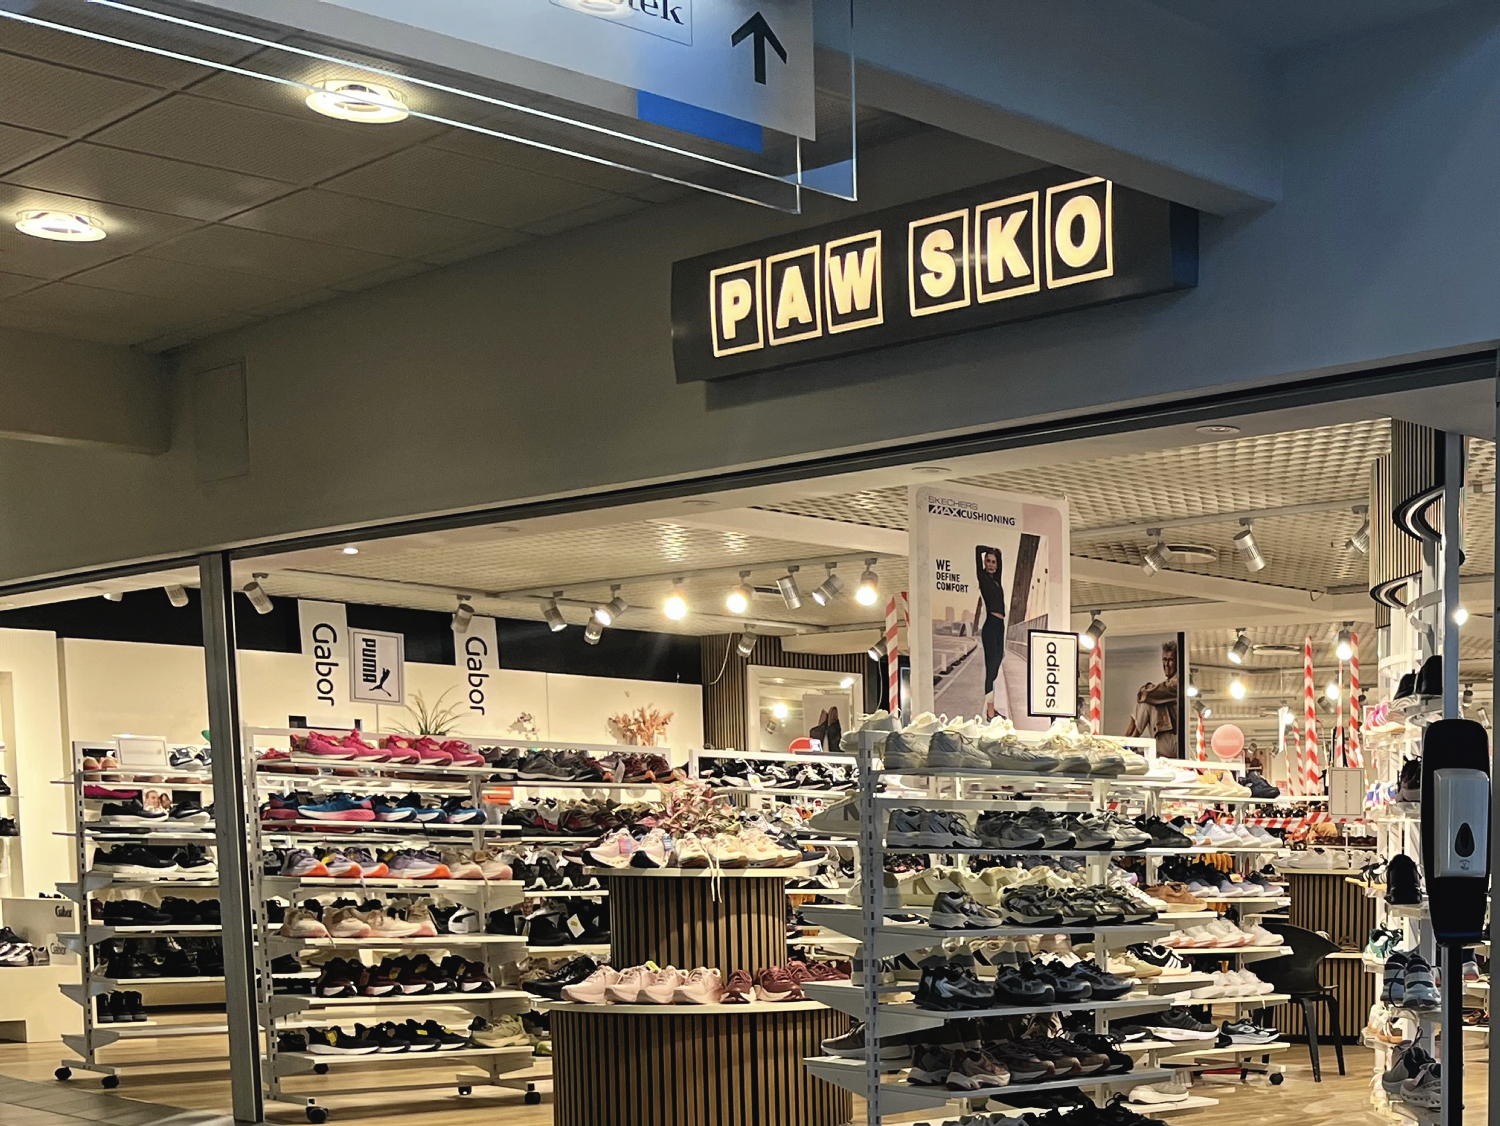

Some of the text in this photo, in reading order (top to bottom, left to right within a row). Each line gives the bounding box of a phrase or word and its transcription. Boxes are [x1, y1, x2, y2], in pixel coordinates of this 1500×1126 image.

[719, 193, 1104, 341] PAW SKO
[928, 495, 979, 511] SKECHERS
[928, 504, 1017, 526] MAX CUSHIONING
[935, 558, 951, 572] WE
[935, 571, 961, 583] DEFINE
[936, 581, 969, 594] COMFORT
[312, 622, 339, 707] Gabor
[361, 637, 377, 684] PUMA
[465, 636, 490, 716] Gabor
[1045, 641, 1060, 709] adidas
[55, 905, 72, 918] Gabor
[50, 942, 67, 956] Gabor
